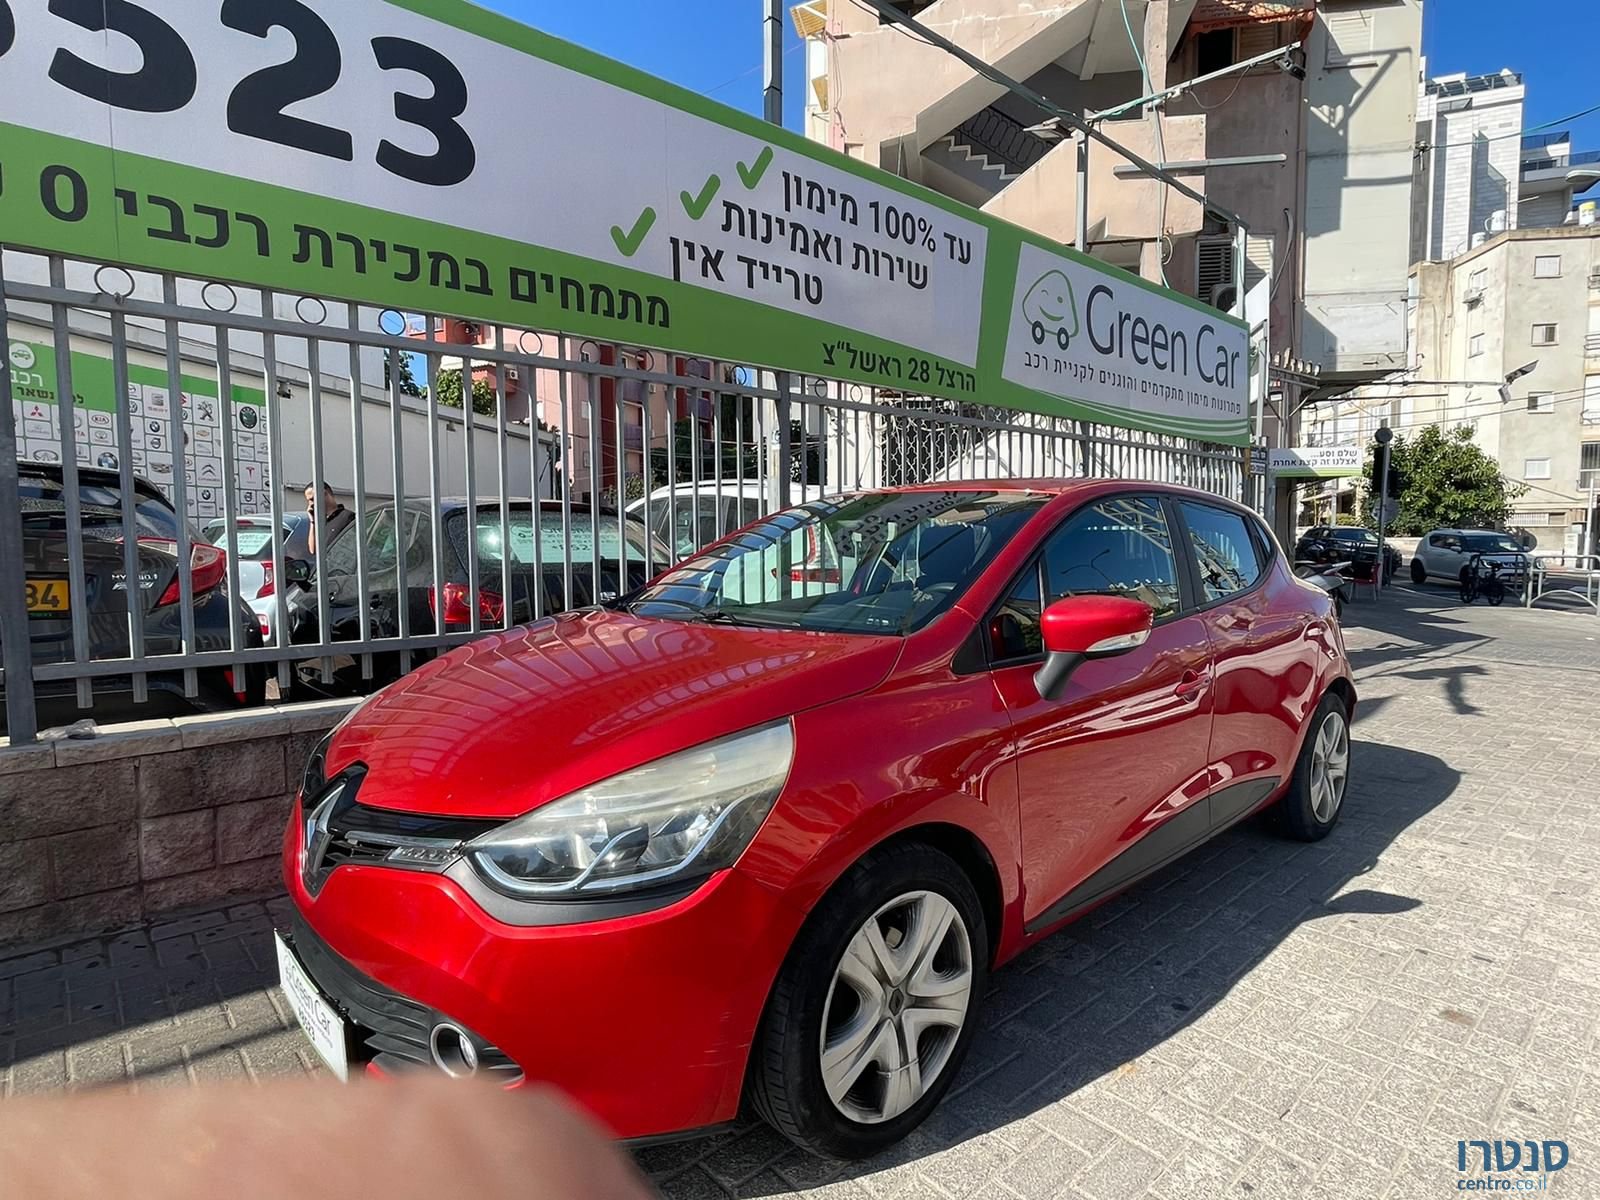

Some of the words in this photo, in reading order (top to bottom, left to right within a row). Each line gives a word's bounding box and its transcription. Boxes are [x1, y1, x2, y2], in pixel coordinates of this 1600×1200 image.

[0, 0, 475, 186] 523
[782, 170, 858, 226] מימון
[114, 188, 270, 257] רכבי
[721, 200, 842, 265] ואמינות
[869, 201, 936, 252] 100%
[292, 224, 493, 296] במכירת
[669, 236, 725, 281] אין
[852, 243, 928, 289] שירות
[943, 231, 971, 264] עד
[509, 266, 670, 328] מתמחים
[737, 254, 823, 305] טרייד
[1086, 284, 1188, 376] Green
[1196, 324, 1240, 389] Car
[908, 357, 930, 383] 28
[936, 362, 975, 392] הרצל
[1024, 351, 1048, 371] רכב
[1054, 363, 1094, 383] לקניית
[1099, 370, 1137, 391] והוגנים
[1141, 380, 1184, 402] מתקדמים
[1211, 397, 1241, 414] פתרונות
